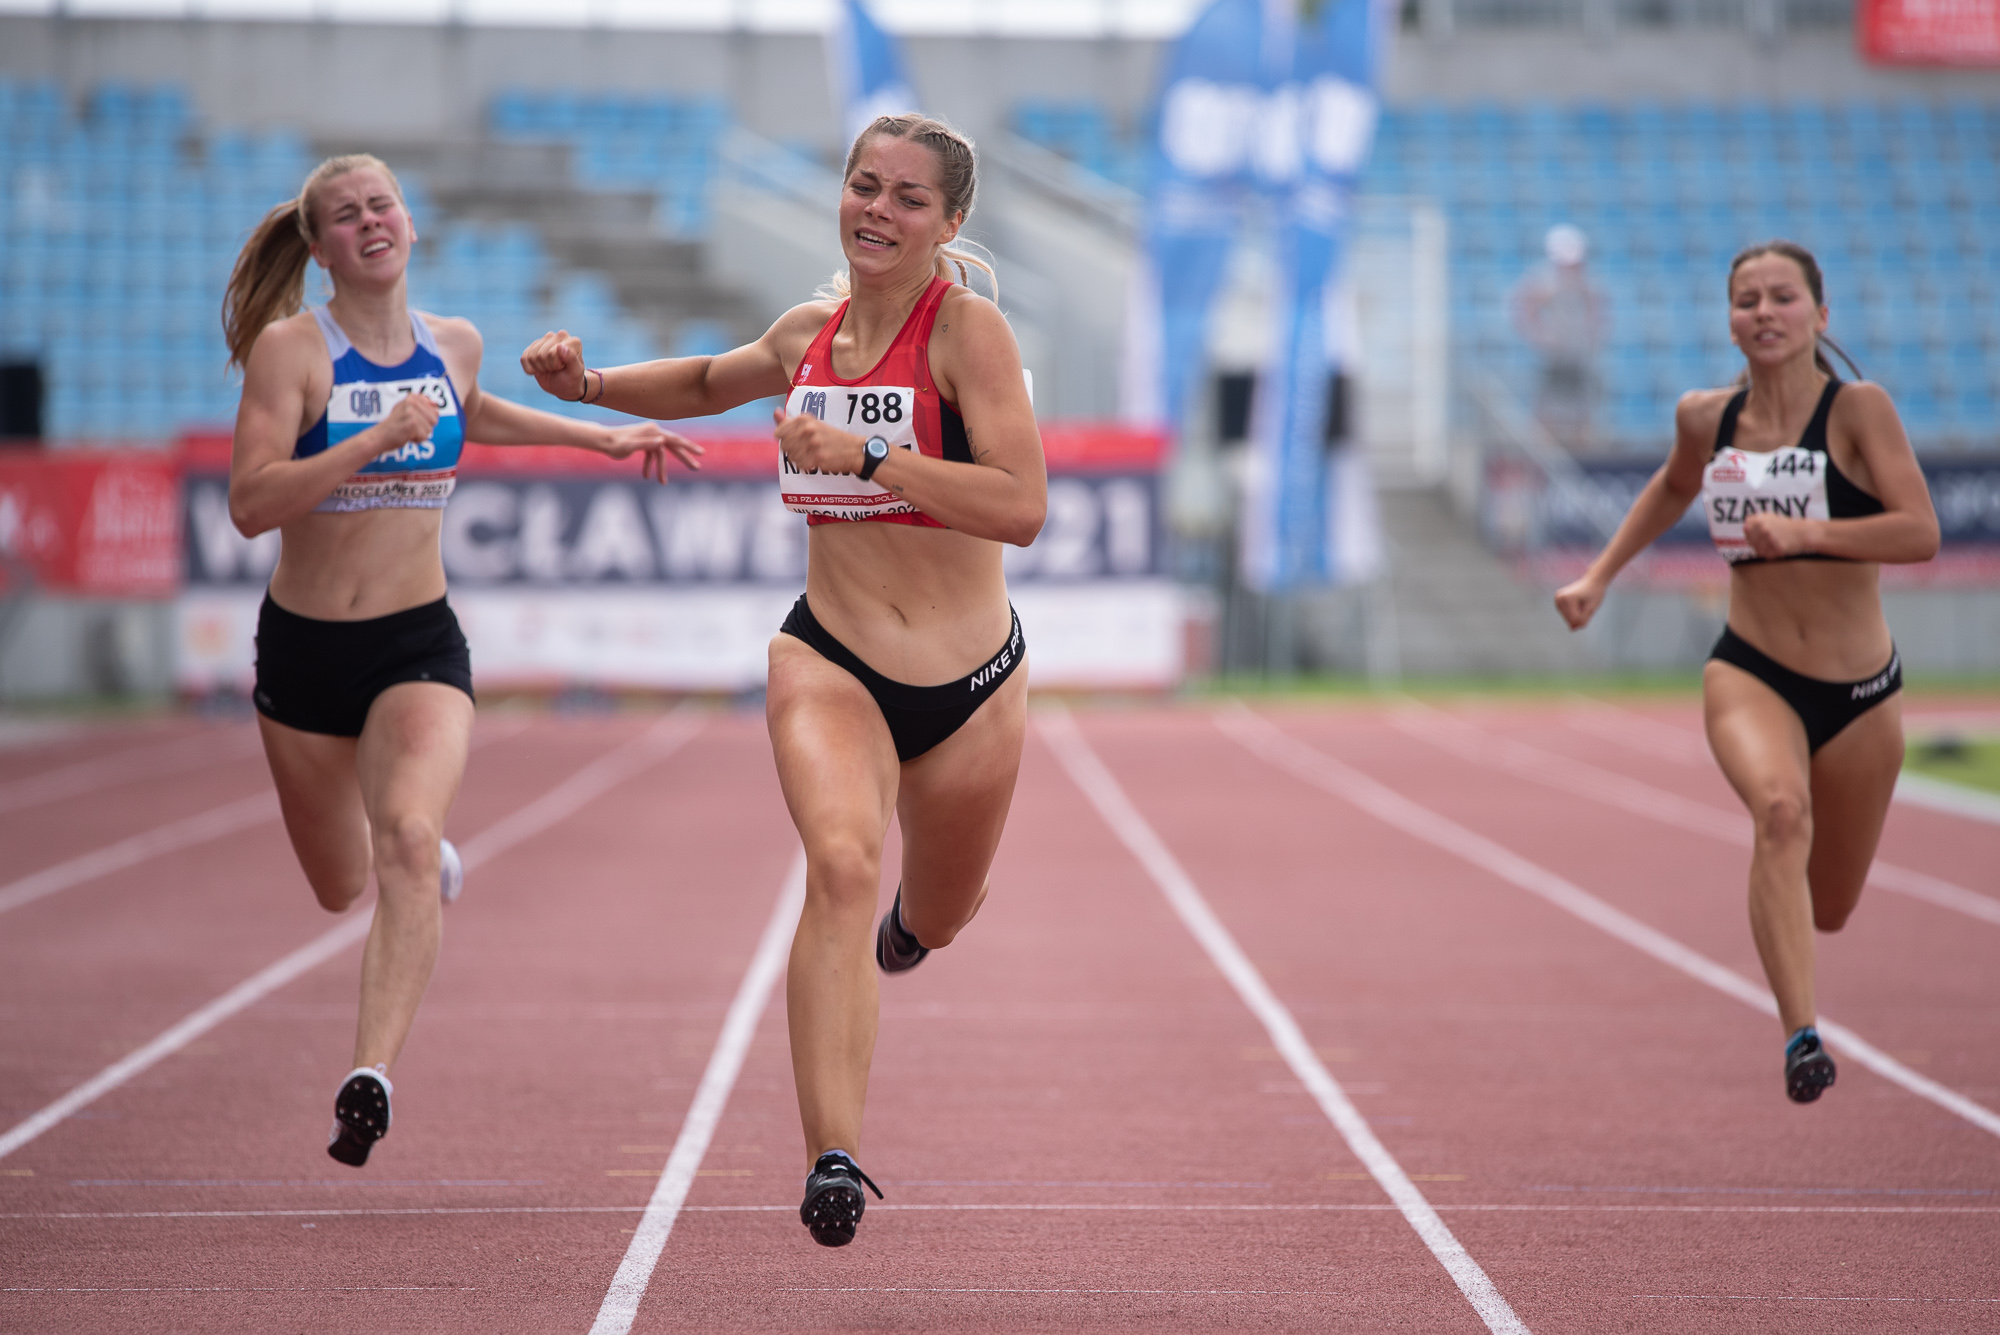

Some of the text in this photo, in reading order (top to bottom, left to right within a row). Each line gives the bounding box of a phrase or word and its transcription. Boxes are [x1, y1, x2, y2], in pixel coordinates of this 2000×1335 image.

[847, 392, 902, 425] 788
[1767, 453, 1815, 478] 444
[421, 482, 448, 495] 2021
[787, 493, 900, 504] 53. PZLA MISTRZOSTWA POLS
[1713, 494, 1810, 524] SZATNY
[970, 648, 1011, 692] NIKE
[1851, 673, 1889, 700] NIKE
